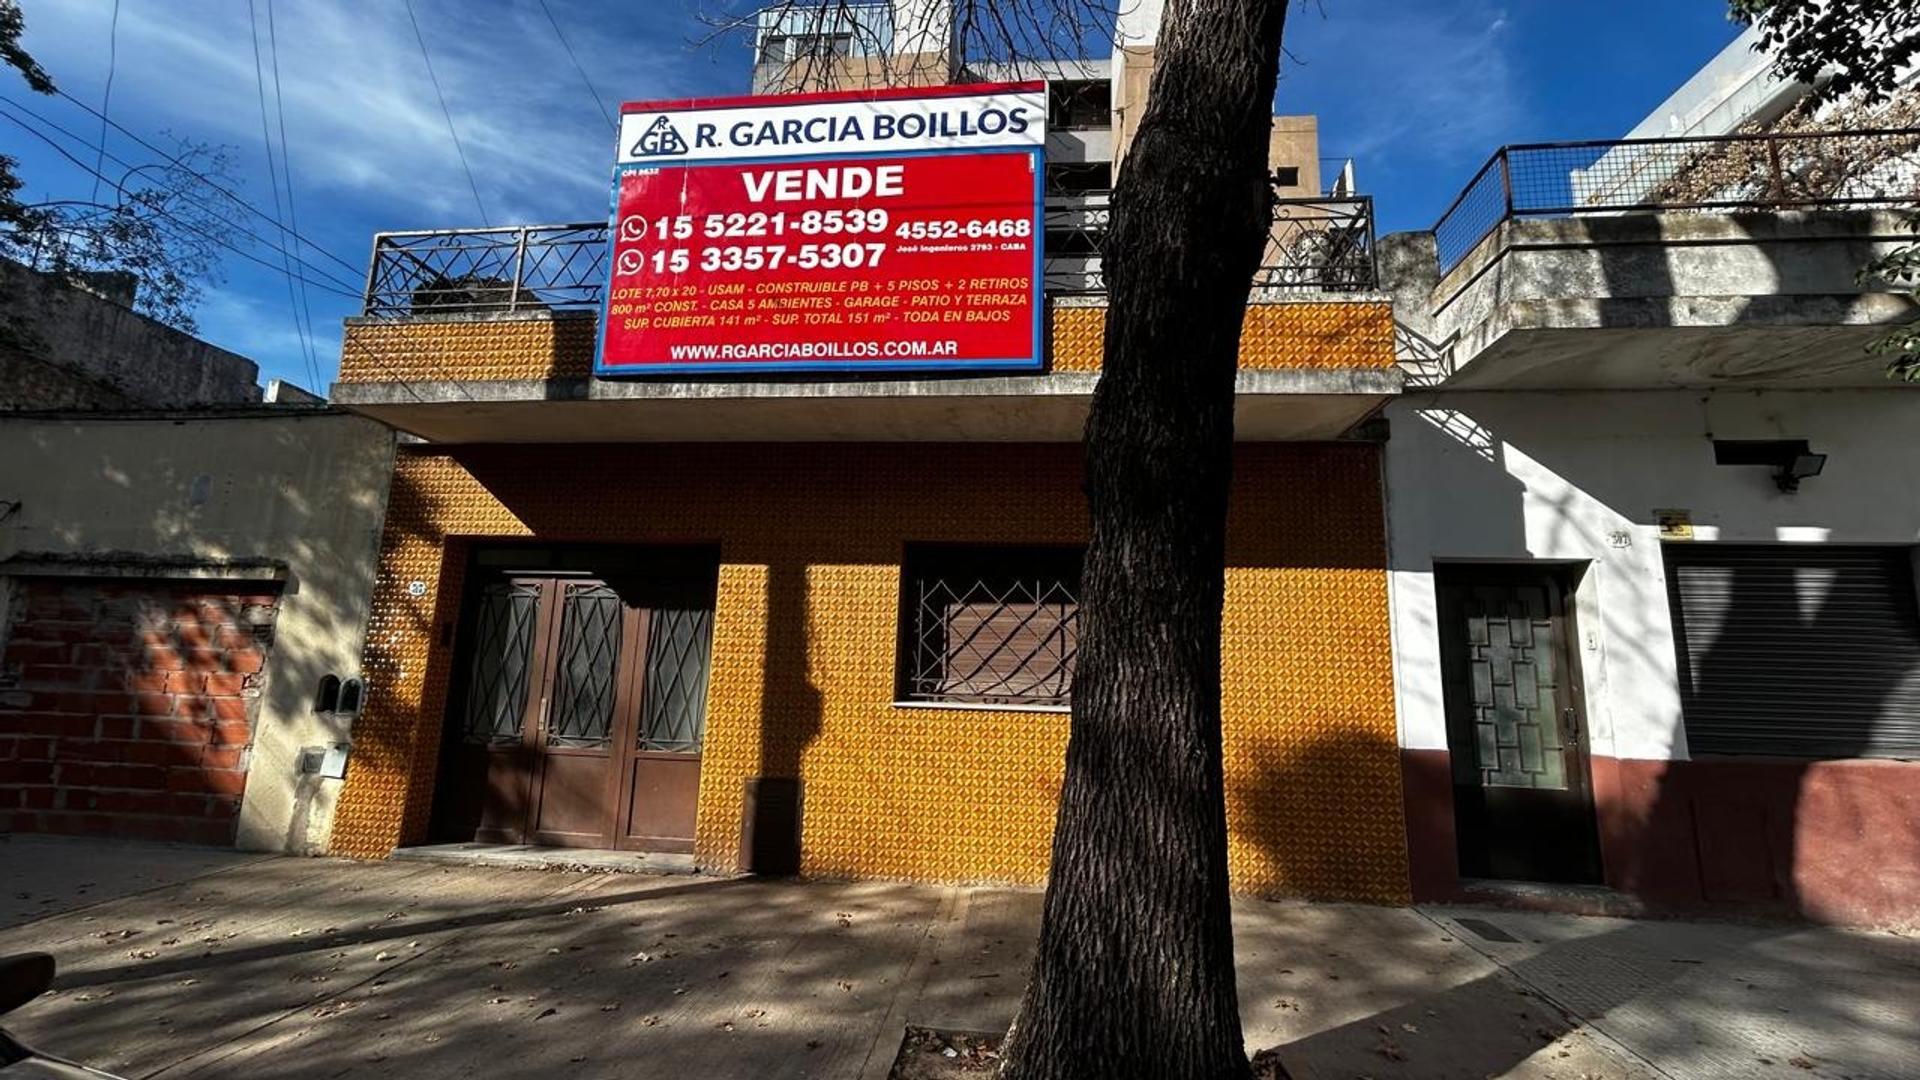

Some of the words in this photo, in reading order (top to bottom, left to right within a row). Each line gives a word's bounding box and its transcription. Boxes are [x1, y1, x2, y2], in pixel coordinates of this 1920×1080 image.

[695, 123, 722, 148] R.
[730, 116, 864, 146] GARCIA
[873, 107, 1029, 140] BOILLOS
[641, 132, 677, 154] GB
[741, 165, 904, 202] VENDE
[655, 216, 693, 240] 15
[704, 208, 888, 238] 5221-8539
[895, 219, 1031, 239] 4552-6468
[651, 249, 690, 273] 15
[701, 243, 886, 272] 3357-5307
[896, 244, 918, 253] José
[919, 244, 968, 254] Ingenieros
[1000, 243, 1026, 251] CABA
[611, 288, 642, 300] LOTE
[645, 286, 670, 299] 7,70
[671, 288, 679, 297] x
[682, 285, 697, 297] 20
[708, 284, 745, 295] USAM
[756, 281, 847, 294] CONSTRUIBLE
[850, 280, 869, 292] PB
[873, 282, 883, 291] +
[887, 280, 895, 291] 5
[899, 279, 940, 291] PISOS
[944, 281, 953, 289] +
[958, 279, 966, 290] 2
[969, 277, 1029, 290] RETIROS
[654, 300, 699, 312] CONST.
[710, 299, 744, 311] CASA
[747, 299, 755, 310] 5
[758, 297, 832, 309] AMBIENTES
[844, 296, 900, 308] GARAGE
[911, 295, 951, 306] PATIO
[954, 295, 962, 305] Y
[966, 293, 1027, 305] TERRAZA
[653, 316, 715, 328] CUBIERTA
[720, 315, 740, 325] 141
[804, 312, 843, 324] TOTAL
[847, 312, 869, 323] 151
[903, 311, 939, 322] TODA
[943, 311, 962, 322] EN
[965, 310, 1011, 321] BAJOS
[671, 341, 958, 359] WWW.RGARCIABOILLOS.COM.AR
